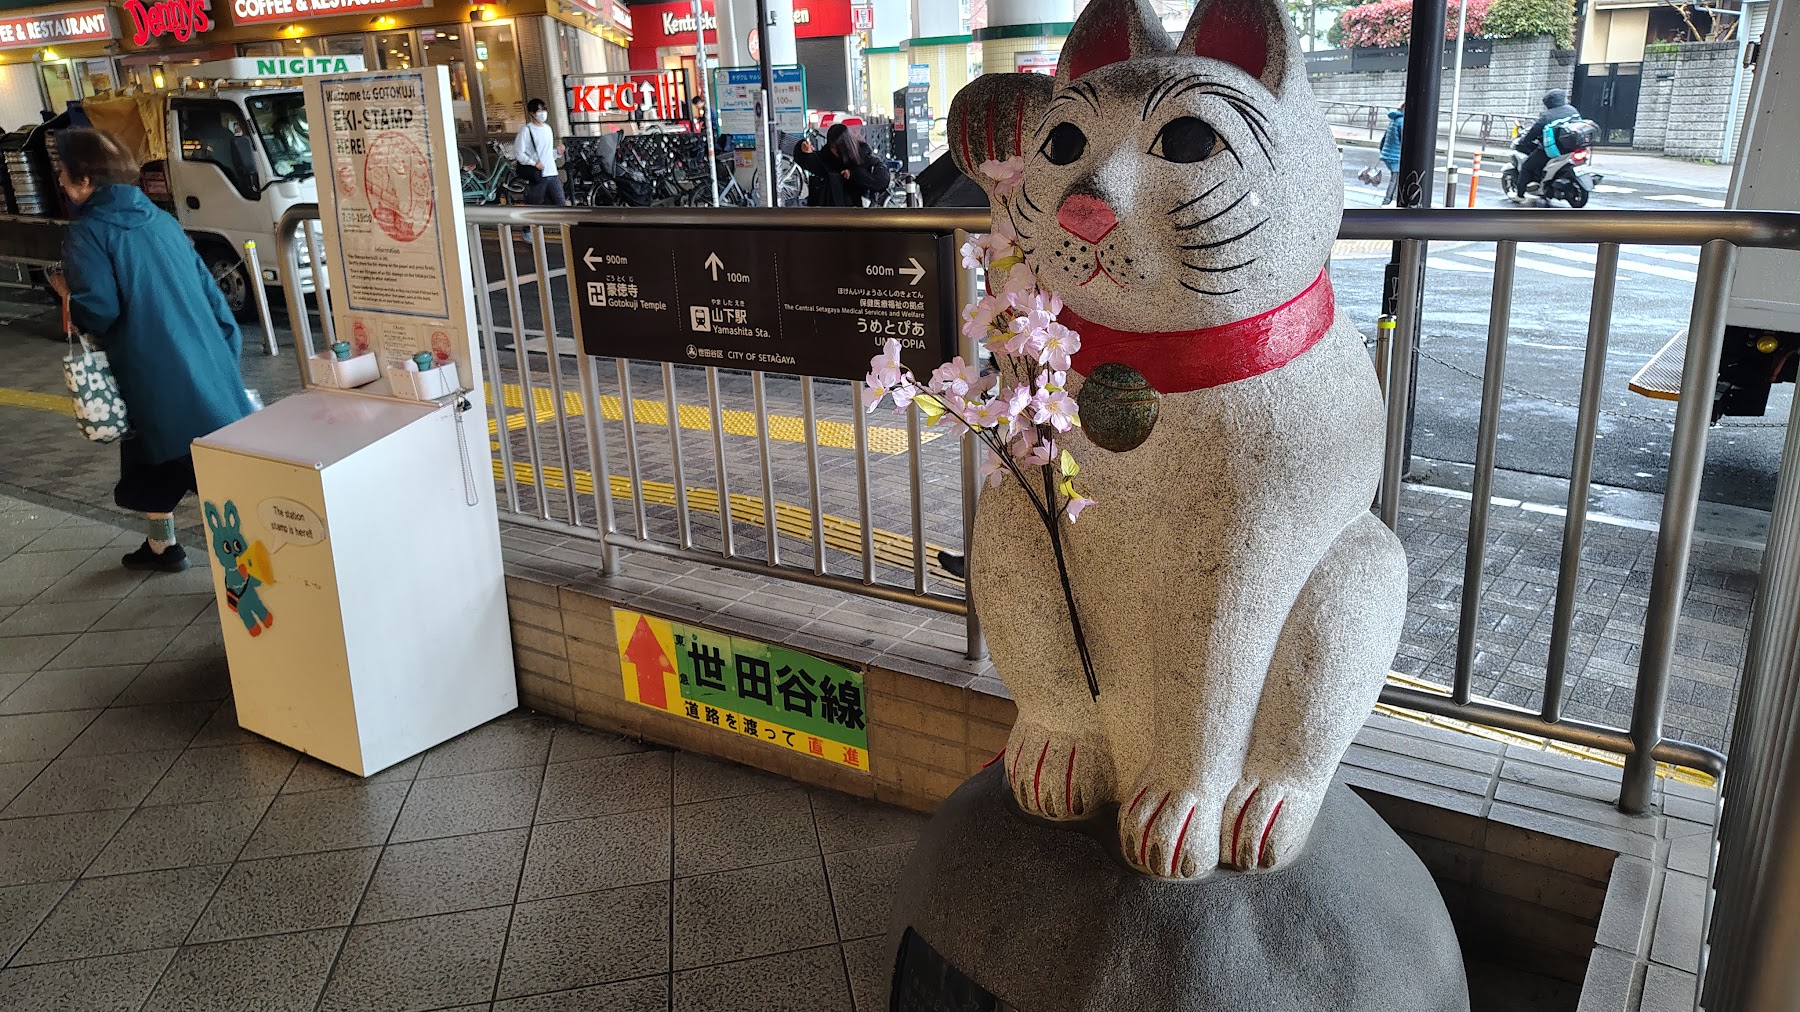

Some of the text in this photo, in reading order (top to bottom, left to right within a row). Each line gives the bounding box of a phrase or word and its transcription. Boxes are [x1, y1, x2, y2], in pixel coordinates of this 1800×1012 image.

[234, 0, 293, 18] COFFEE
[295, 0, 308, 12] &
[16, 24, 26, 40] &
[28, 14, 105, 39] RESTAURANT
[257, 58, 349, 75] NIGITA
[572, 82, 637, 113] KFC
[333, 108, 413, 131] EKI-STAMP
[336, 138, 366, 155] HERE!
[605, 254, 628, 265] 900m
[727, 272, 750, 283] 100m
[866, 265, 894, 276] 600m
[606, 282, 638, 298] 豪徳寺
[608, 298, 667, 311] Gotokuji Temple
[795, 304, 815, 312] Central
[816, 305, 840, 314] Setagaya
[841, 307, 863, 315] Medical
[860, 299, 925, 310] 保健医療福祉の拠点
[711, 308, 747, 325] 山下駅
[712, 325, 771, 339] Yamashita Sta.
[857, 318, 925, 337] うめとぴあ
[698, 348, 724, 359] 世田谷区
[727, 348, 796, 364] CITY OF SETAGAYA
[273, 505, 305, 522] The station
[289, 525, 294, 535] is
[688, 641, 866, 731] 世田谷線
[685, 701, 860, 767] 道路を渡って 直進
